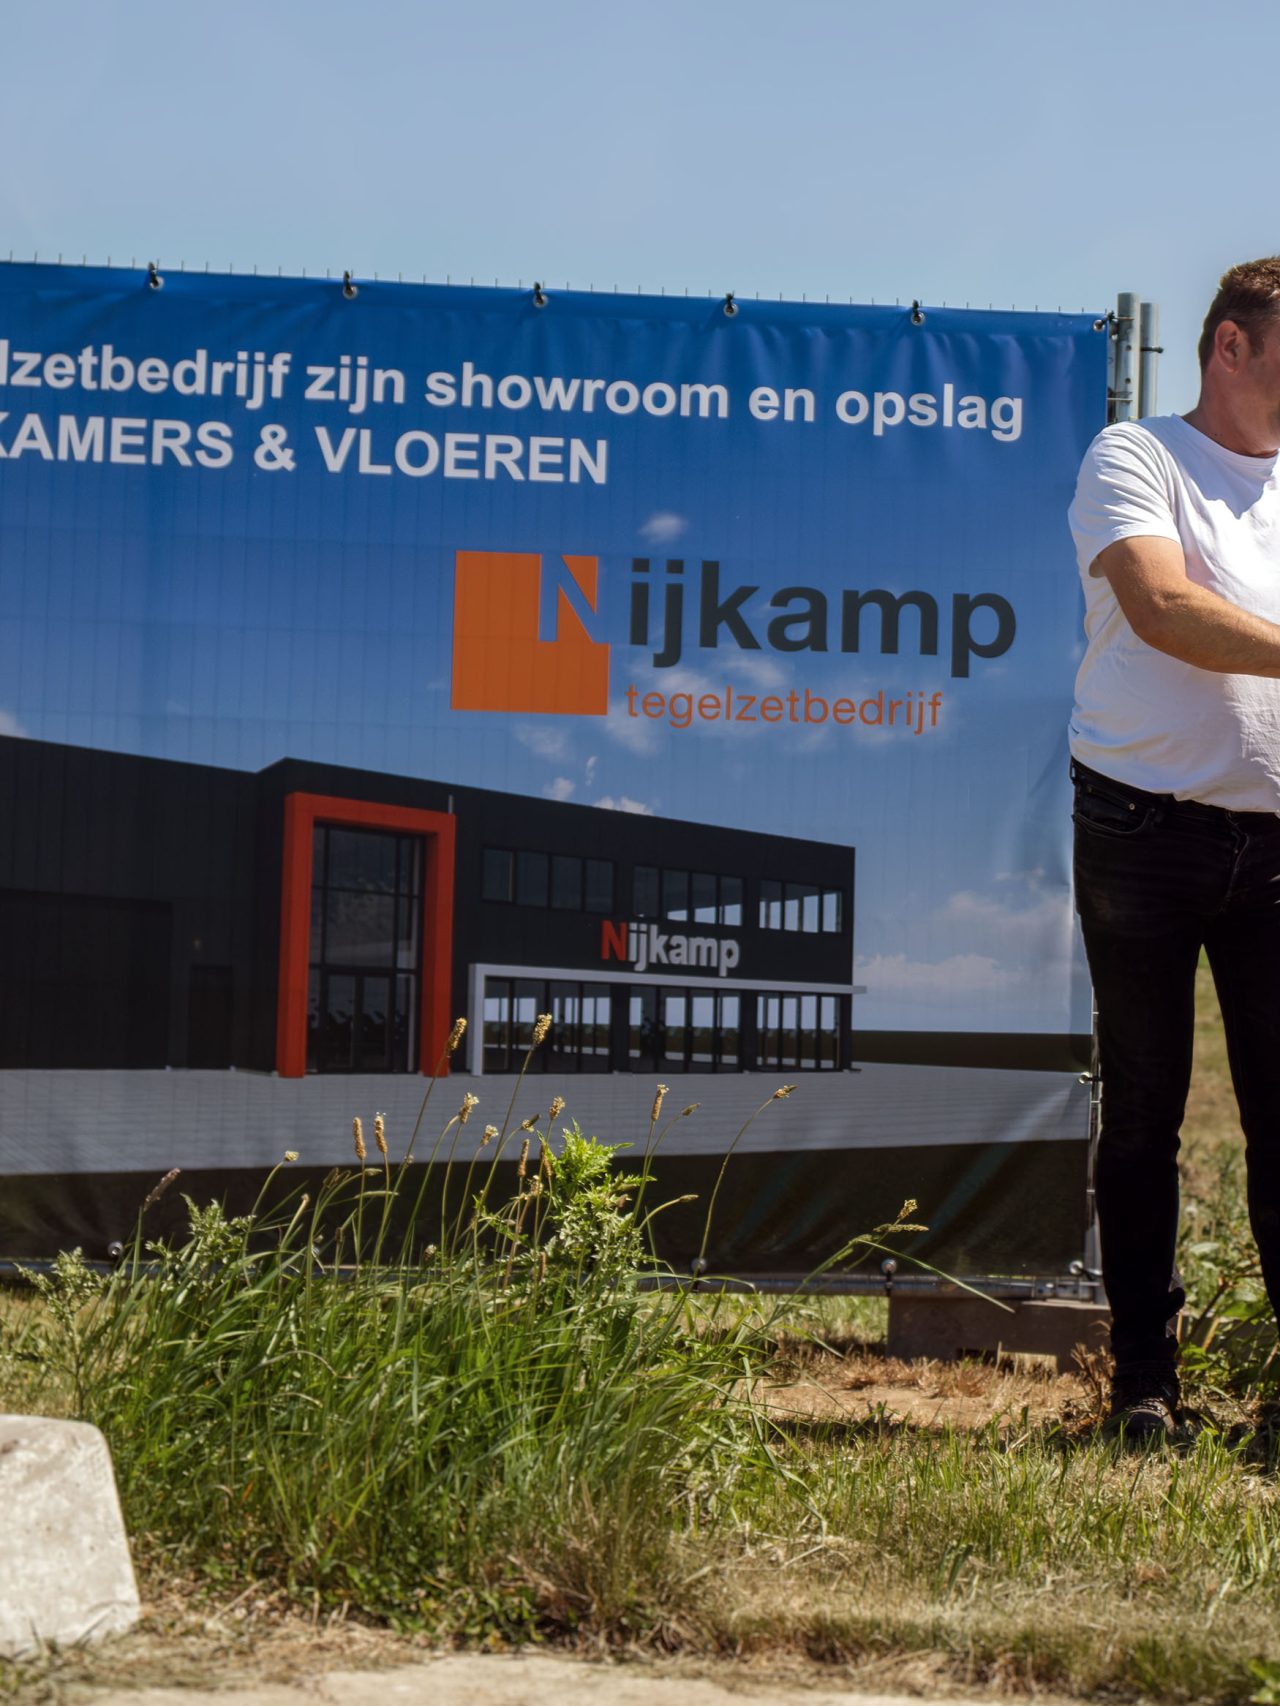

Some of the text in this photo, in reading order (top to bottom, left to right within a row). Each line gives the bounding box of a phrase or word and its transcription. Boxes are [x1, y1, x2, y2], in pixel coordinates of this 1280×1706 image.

[0, 339, 1024, 442] lzetbedrijf zijn showroom en opslag
[0, 411, 608, 485] AMERS & VLOEREN
[538, 554, 1018, 679] Nijkamp
[625, 684, 944, 735] tegelzetbedrijf
[601, 919, 740, 978] Nijkamp
